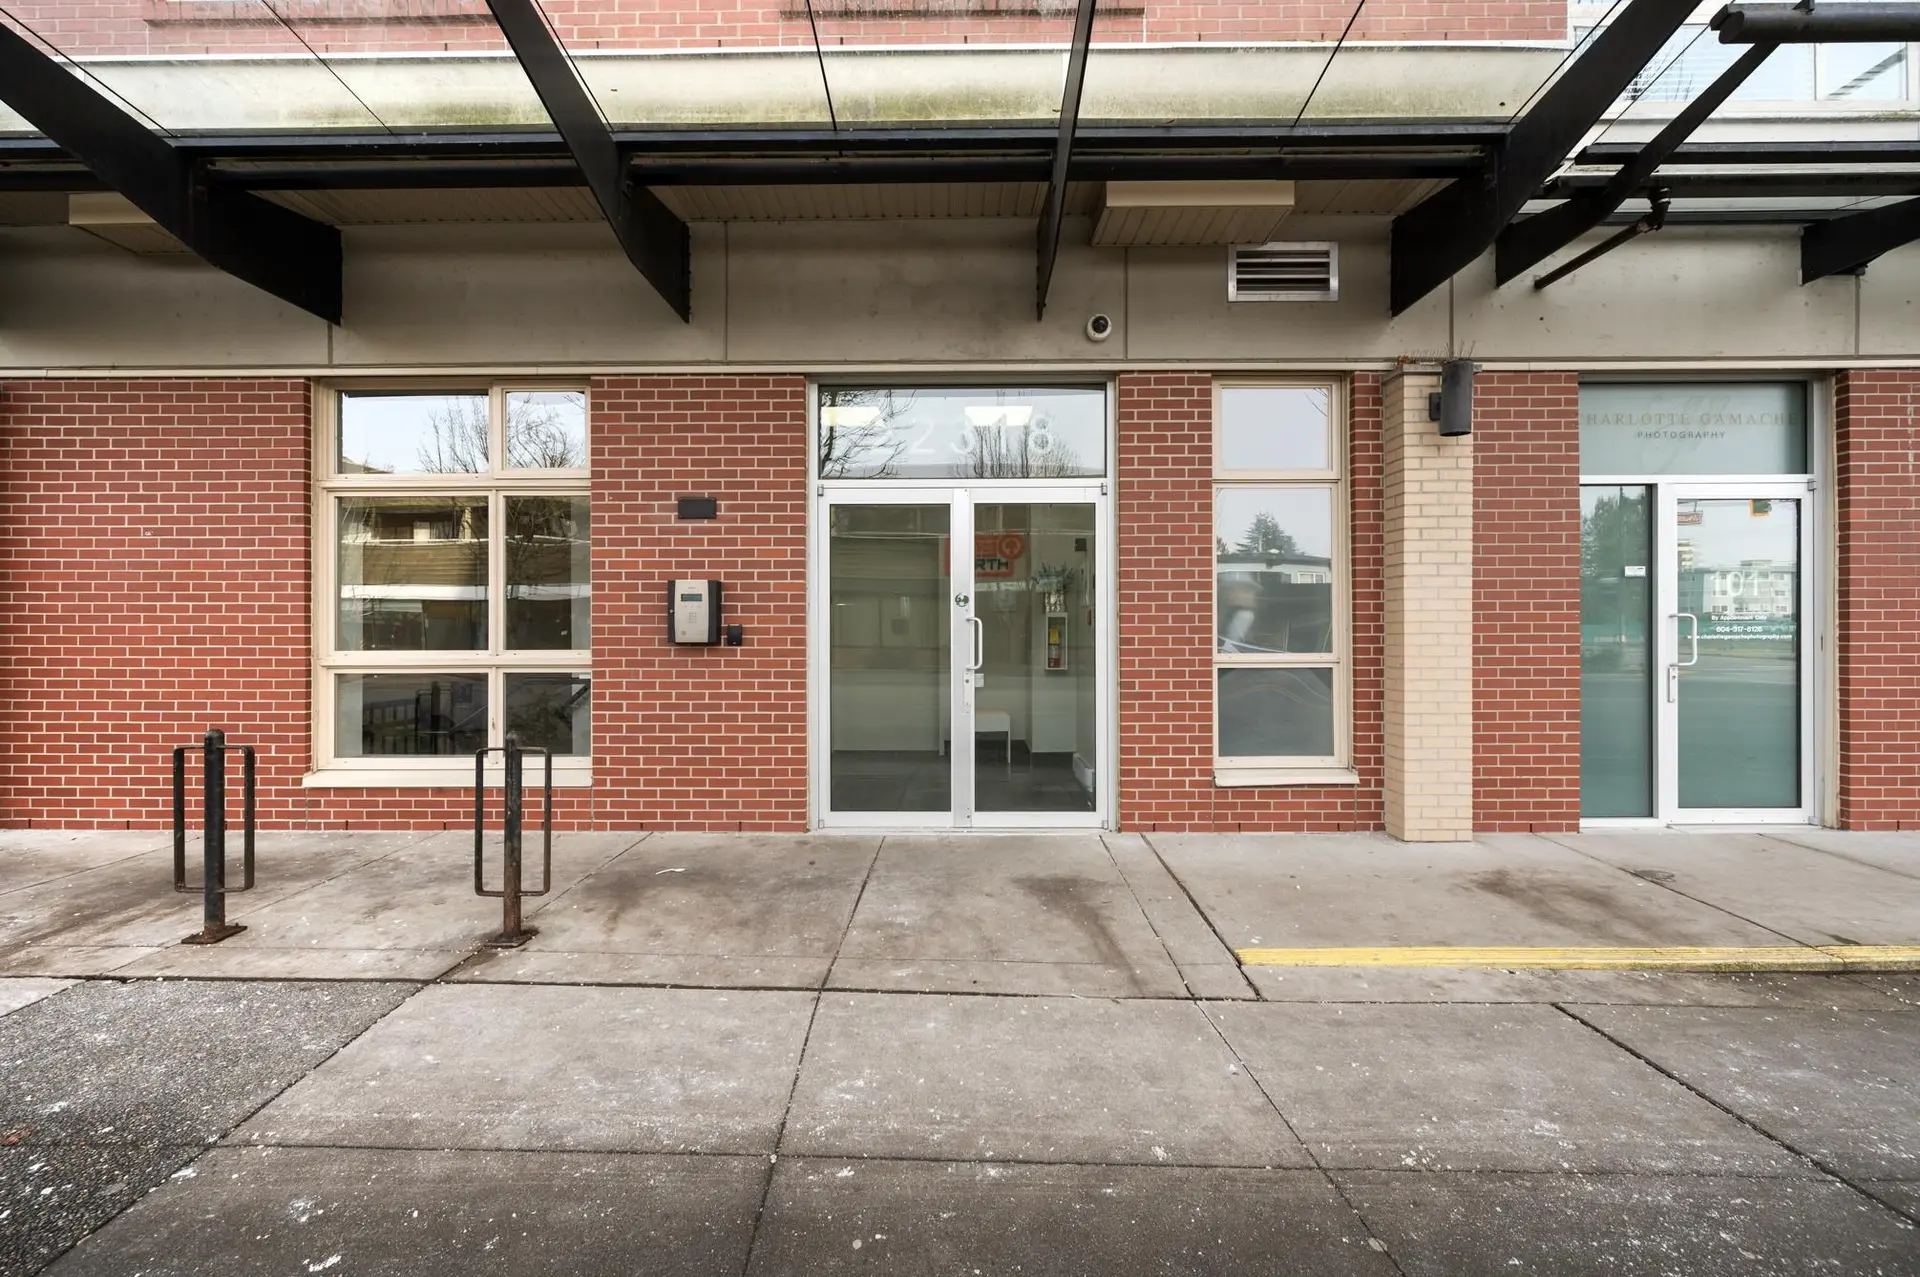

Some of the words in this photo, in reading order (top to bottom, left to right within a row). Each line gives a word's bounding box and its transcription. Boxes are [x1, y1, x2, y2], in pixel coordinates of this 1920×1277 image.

[1580, 412, 1691, 425] HARLOTTE
[1700, 412, 1798, 425] GAMACHE
[1636, 430, 1727, 439] PHOTOGRAPHY
[1710, 571, 1759, 597] 101
